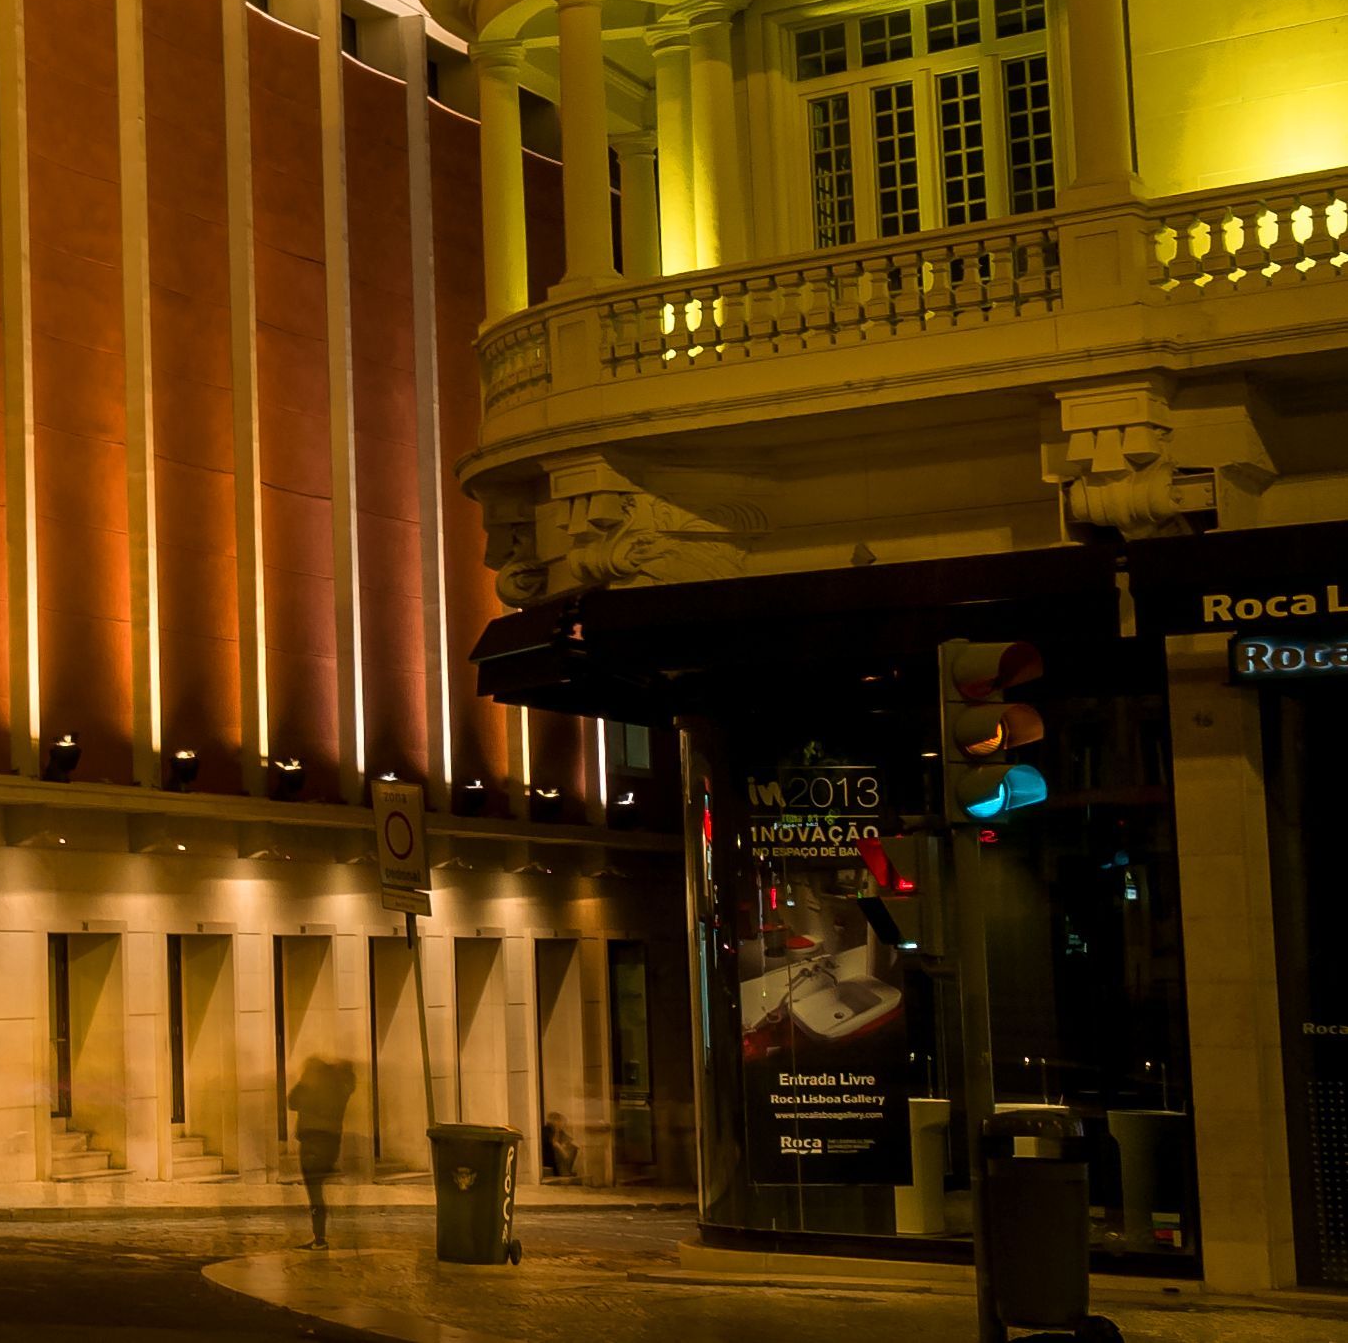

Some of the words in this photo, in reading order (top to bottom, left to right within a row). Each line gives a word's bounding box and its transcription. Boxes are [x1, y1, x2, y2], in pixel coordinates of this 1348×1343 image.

[1203, 594, 1316, 622] Roca
[1237, 641, 1348, 674] Roca
[750, 822, 879, 846] INOVAÇÃO
[752, 847, 769, 857] NO
[772, 847, 817, 859] ESPAÇO
[821, 847, 836, 857] DE
[839, 847, 862, 857] BAN
[1303, 1022, 1348, 1035] Roca
[779, 1072, 837, 1086] Entrada
[840, 1072, 876, 1086] Livre
[770, 1093, 801, 1105] Roca
[802, 1093, 841, 1104] Lisboa
[843, 1093, 885, 1106] Gallery
[780, 1135, 823, 1149] Roca
[502, 1145, 515, 1245] ROCA
